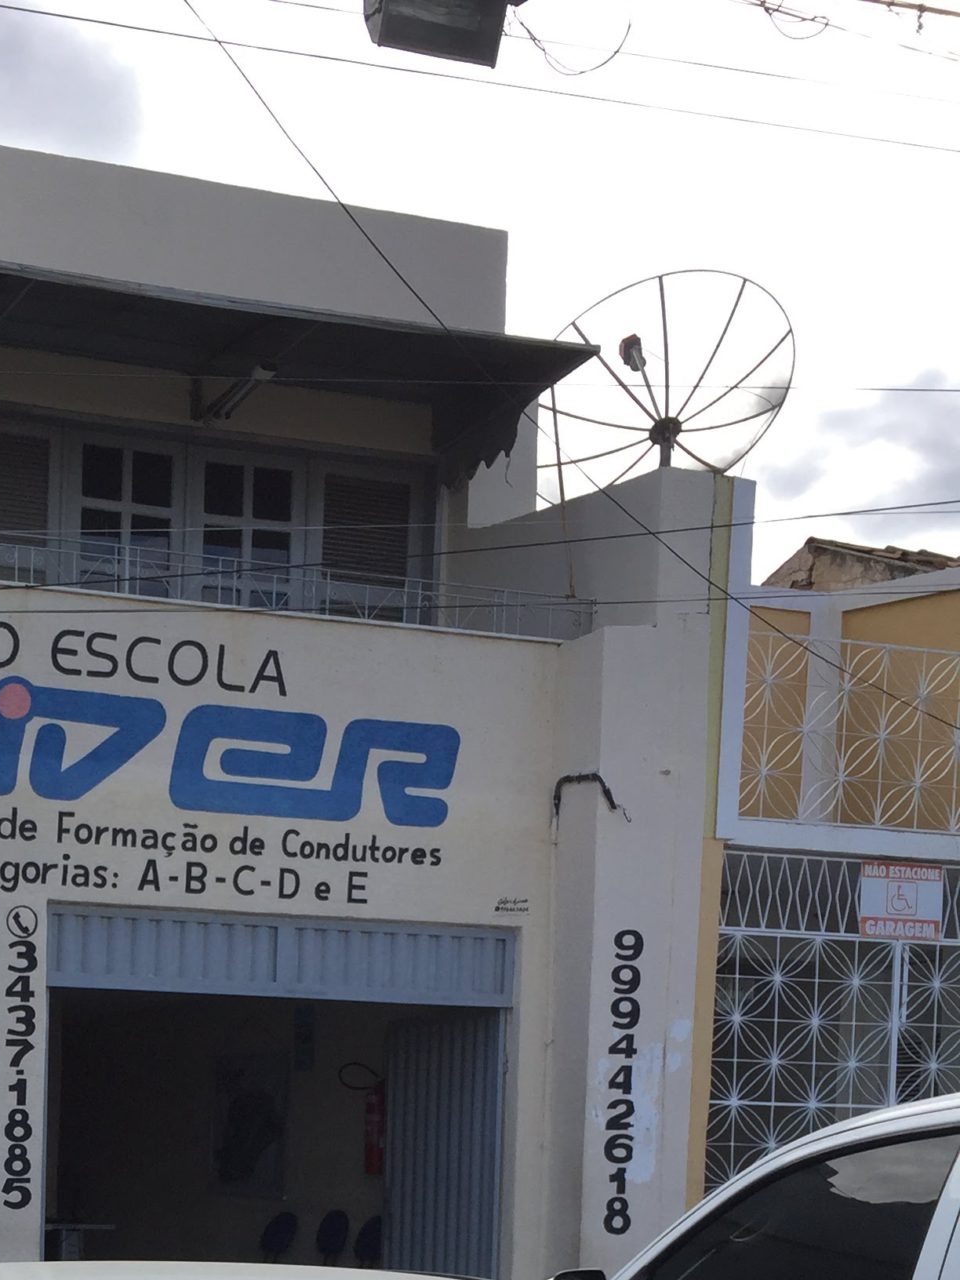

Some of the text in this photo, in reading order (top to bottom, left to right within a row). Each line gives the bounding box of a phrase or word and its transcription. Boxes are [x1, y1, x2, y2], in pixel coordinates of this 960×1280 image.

[49, 629, 288, 697] ESCOLA
[56, 812, 218, 858] Formação
[228, 825, 266, 857] de
[280, 829, 443, 868] Condutores
[313, 880, 331, 902] e
[346, 872, 369, 905] E
[863, 863, 941, 880] NÃO ESTACIONE
[865, 919, 936, 940] GARAGEM
[602, 929, 645, 1237] 999442618
